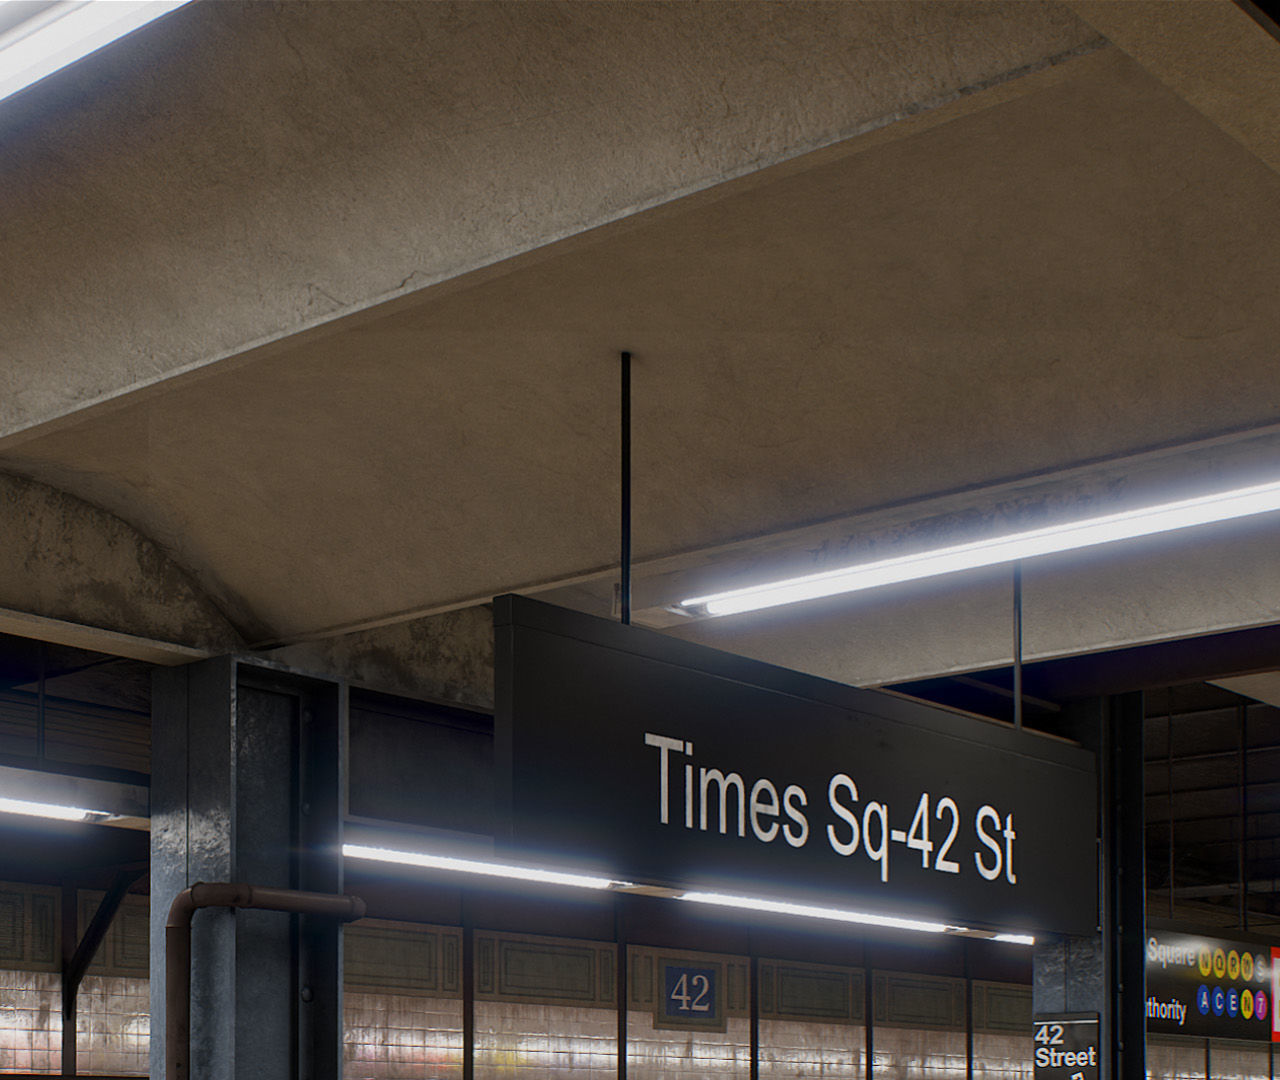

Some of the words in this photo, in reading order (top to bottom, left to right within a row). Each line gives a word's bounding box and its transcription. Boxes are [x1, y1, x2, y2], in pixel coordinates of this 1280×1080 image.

[644, 733, 809, 848] Times
[826, 773, 960, 883] Sq-42
[973, 804, 1017, 884] St
[1147, 937, 1197, 969] Square
[670, 973, 710, 1012] 42
[1034, 1025, 1065, 1045] 42
[1034, 1046, 1097, 1068] Street
